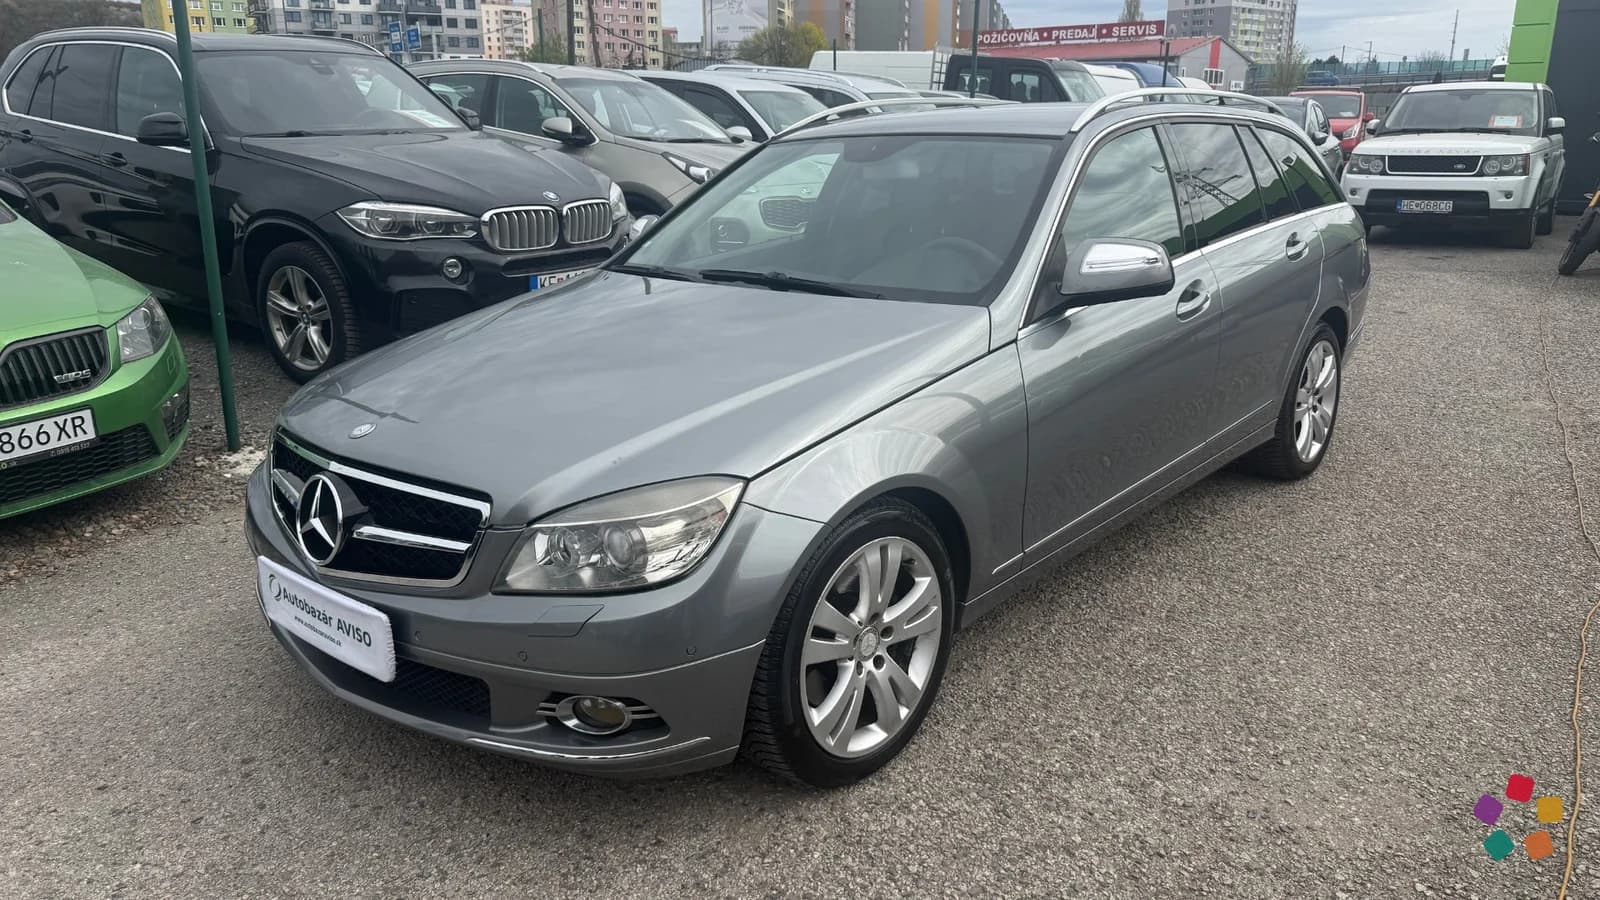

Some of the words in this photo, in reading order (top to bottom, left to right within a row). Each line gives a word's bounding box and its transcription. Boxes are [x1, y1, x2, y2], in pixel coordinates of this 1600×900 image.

[1052, 28, 1096, 40] PREDAJ
[1111, 24, 1157, 37] SERVIS
[283, 587, 333, 627] Autobazár
[337, 618, 372, 648] AVISO
